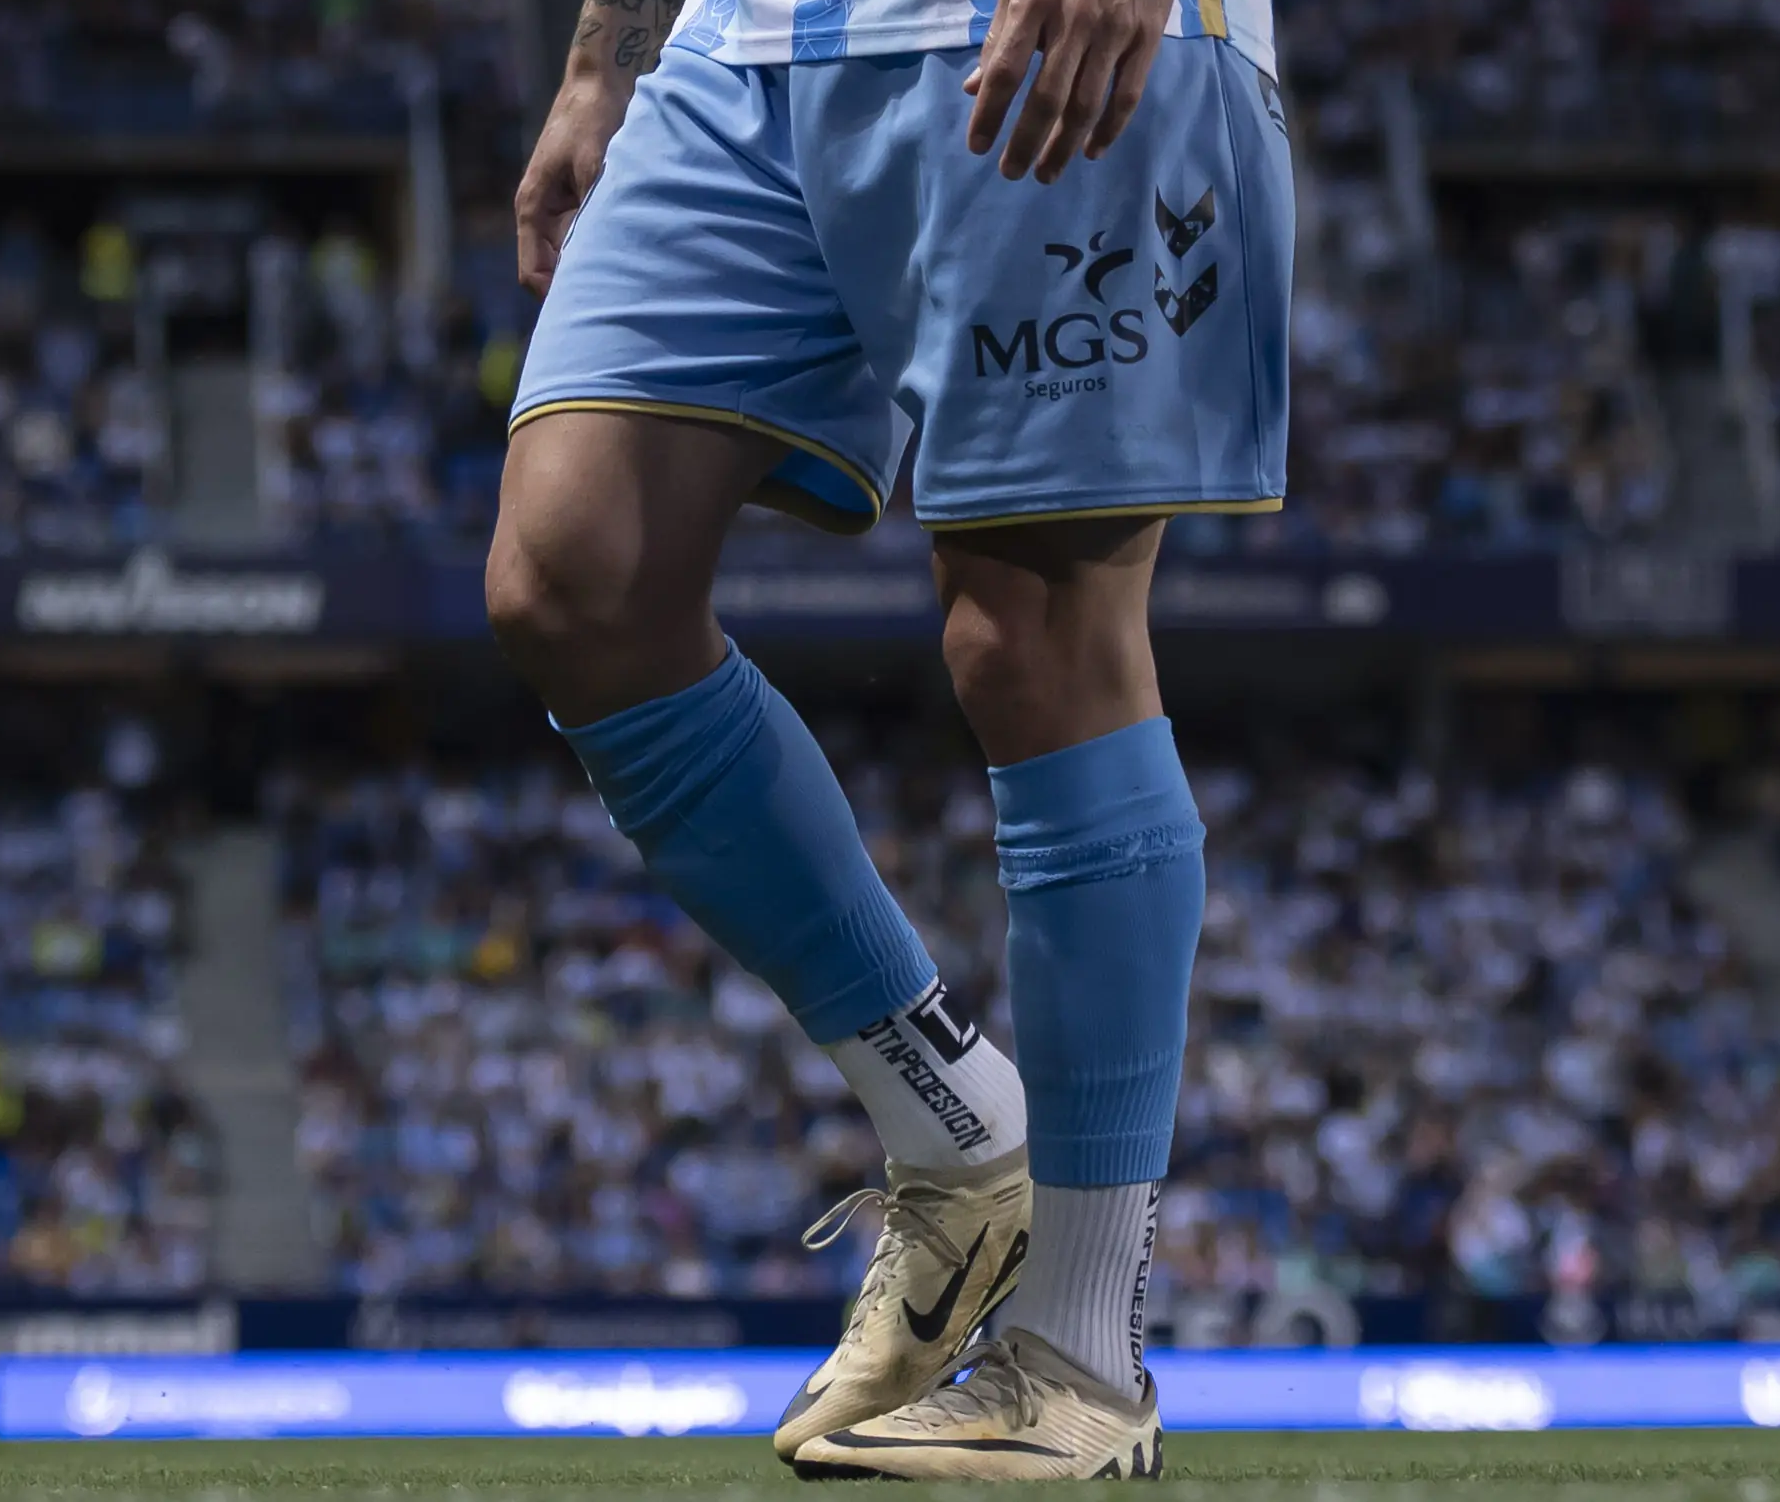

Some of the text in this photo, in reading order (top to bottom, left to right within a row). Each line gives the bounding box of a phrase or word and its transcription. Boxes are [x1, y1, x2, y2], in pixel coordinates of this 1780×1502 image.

[971, 309, 1149, 378] MGS
[1024, 376, 1107, 401] Seguros
[873, 1028, 992, 1151] TAPEDESIGN
